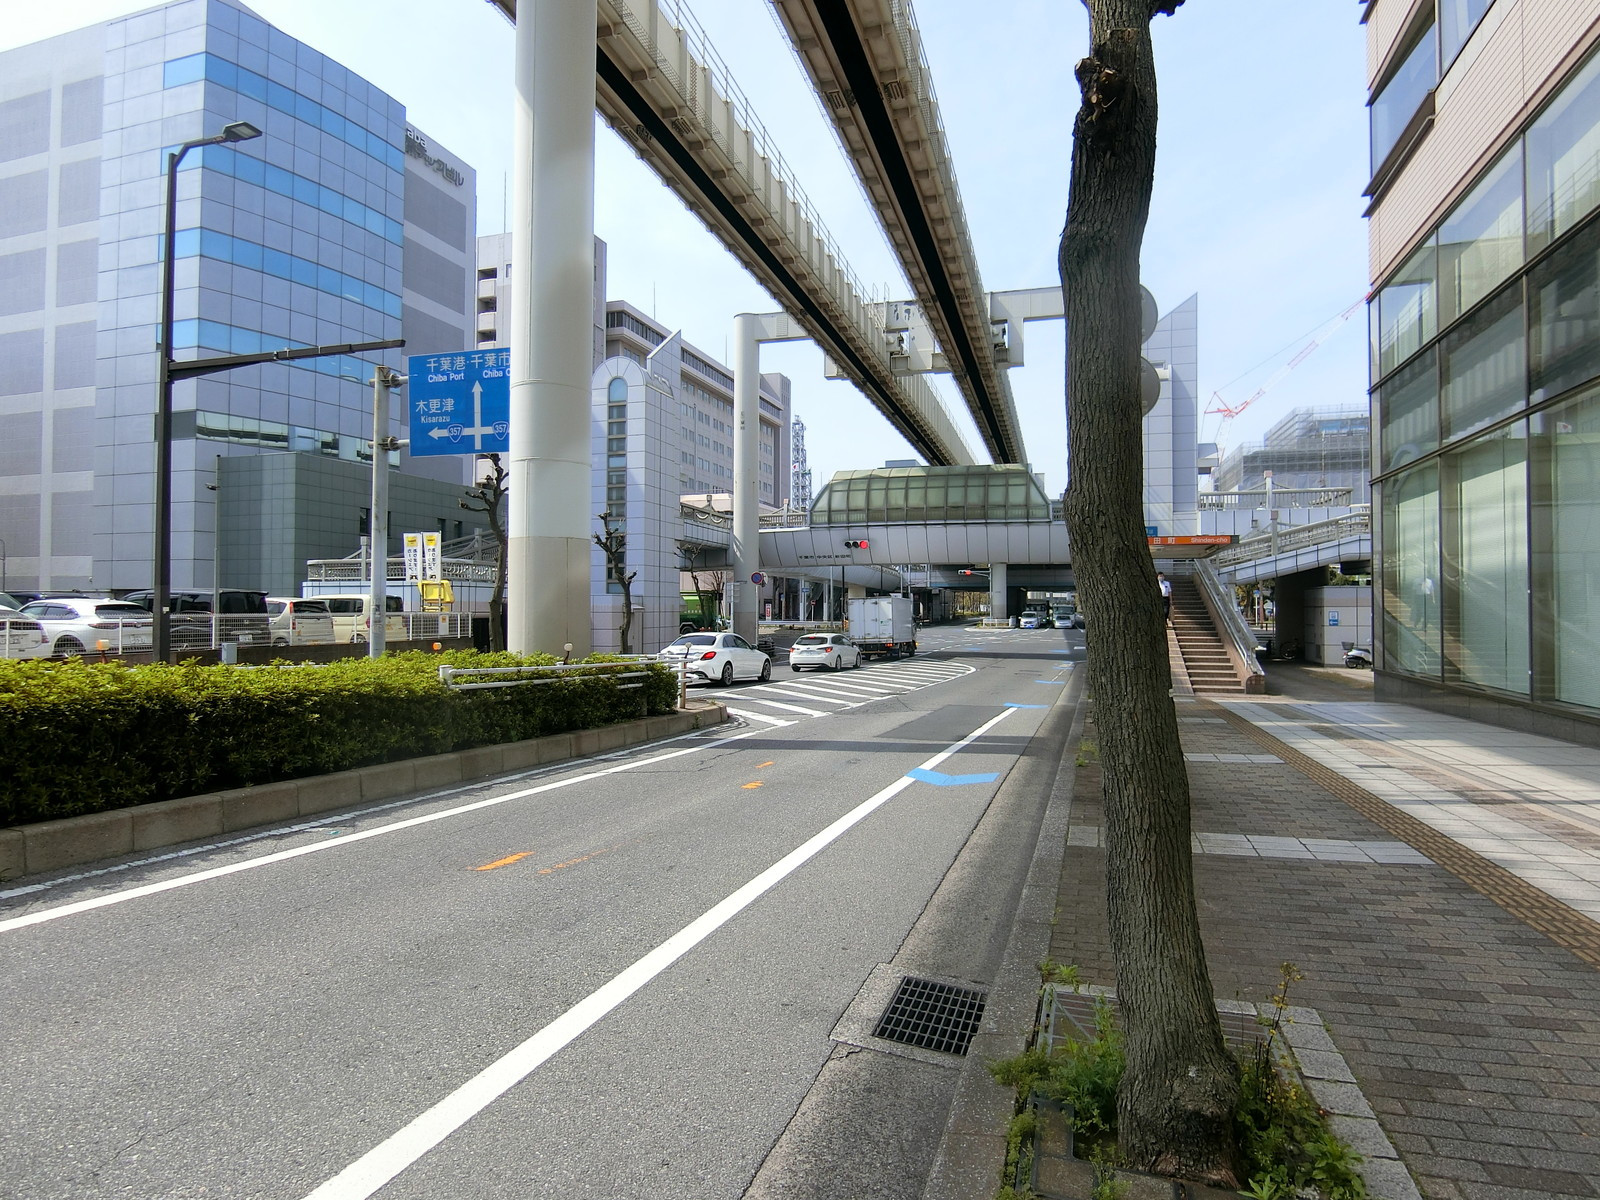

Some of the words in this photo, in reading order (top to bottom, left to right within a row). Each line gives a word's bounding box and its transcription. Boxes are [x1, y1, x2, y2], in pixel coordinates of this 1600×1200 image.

[428, 374, 448, 383] Chiba
[449, 372, 465, 381] Port
[482, 369, 503, 379] Chiba
[415, 398, 455, 414] 木更津
[421, 415, 451, 424] Kisarazu
[449, 427, 461, 436] 357
[494, 424, 507, 433] 357
[1190, 536, 1228, 544] Shinden-cho
